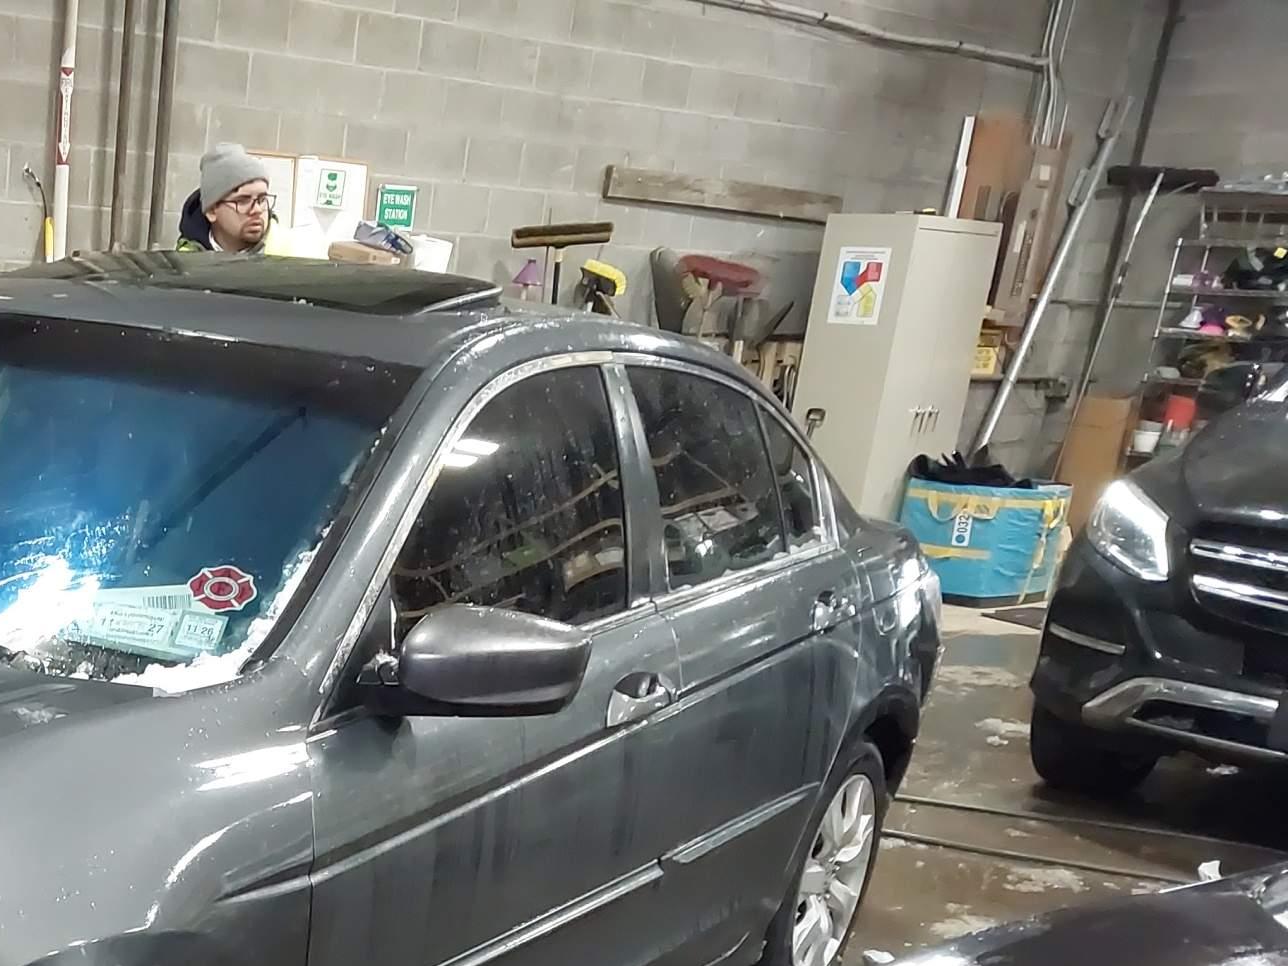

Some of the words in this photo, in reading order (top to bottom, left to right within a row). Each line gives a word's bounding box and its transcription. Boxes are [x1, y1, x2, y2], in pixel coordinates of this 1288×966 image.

[383, 193, 395, 205] EYE
[395, 194, 411, 205] WASH
[384, 208, 407, 220] STATION
[148, 623, 164, 634] 27
